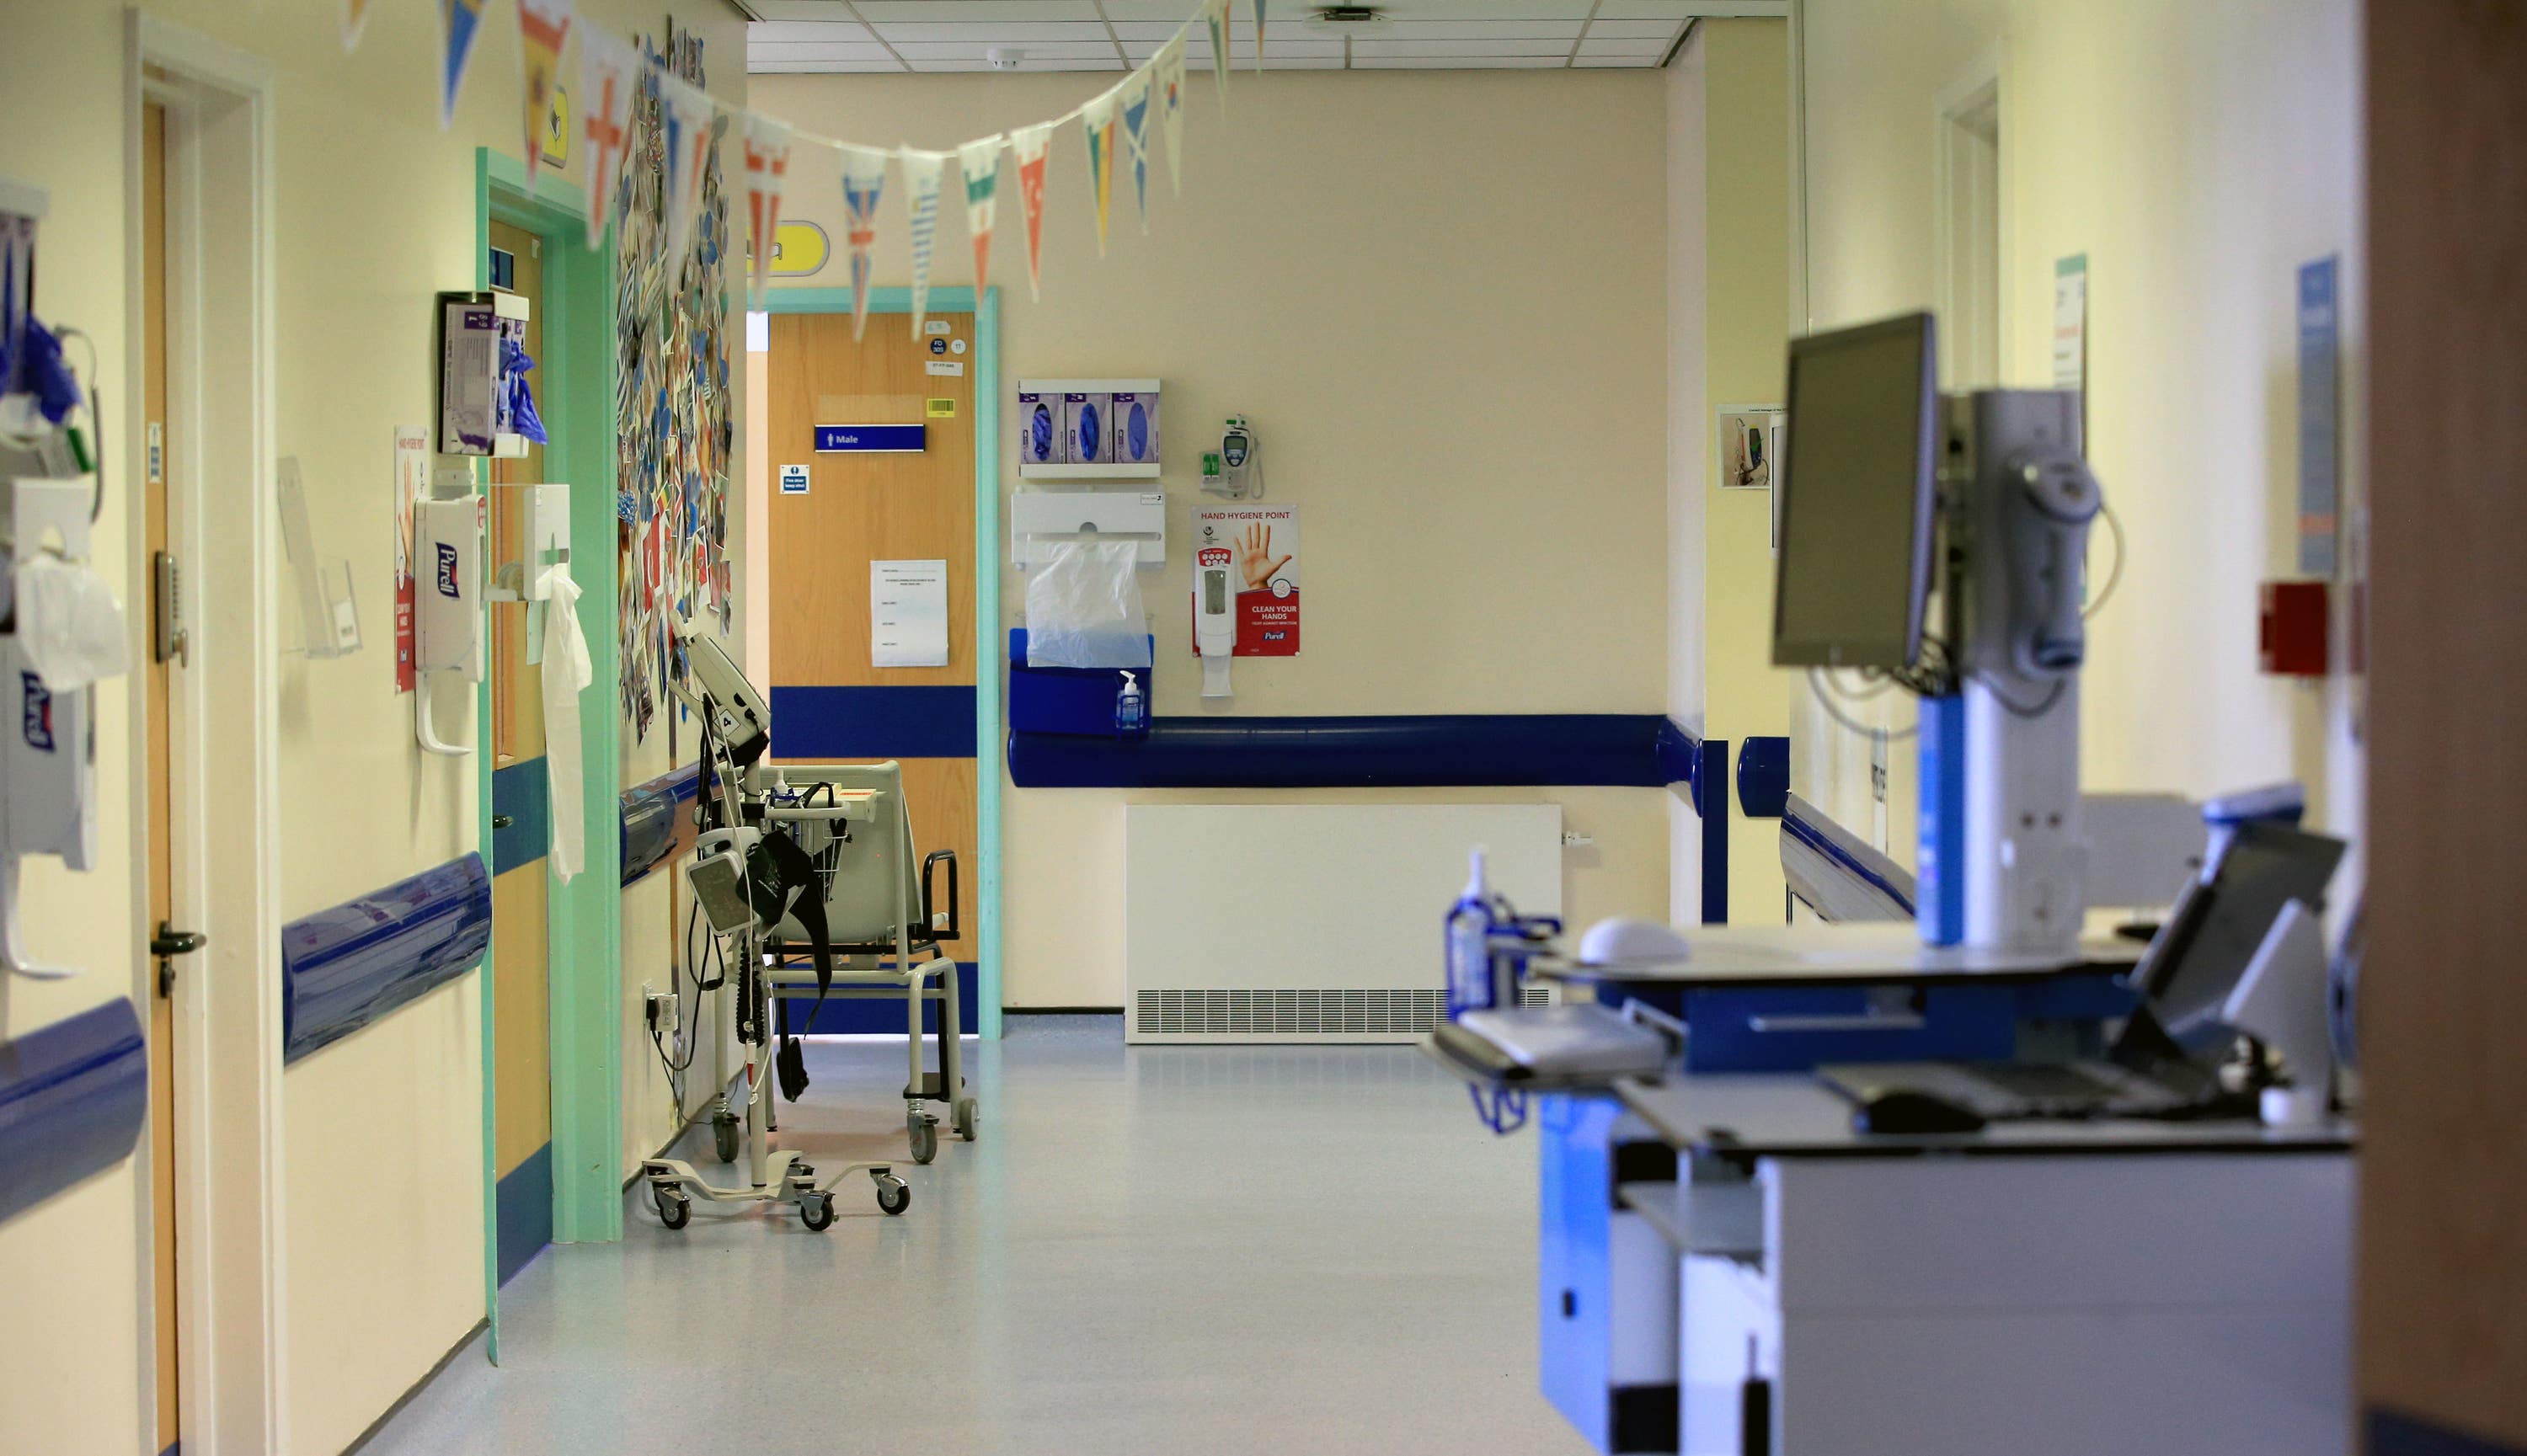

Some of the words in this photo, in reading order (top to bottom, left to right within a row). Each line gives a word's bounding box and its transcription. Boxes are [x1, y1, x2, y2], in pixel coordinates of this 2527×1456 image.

[836, 435, 858, 444] Male
[440, 549, 456, 594] Purell
[1264, 632, 1285, 640] Purell
[724, 717, 731, 727] 4
